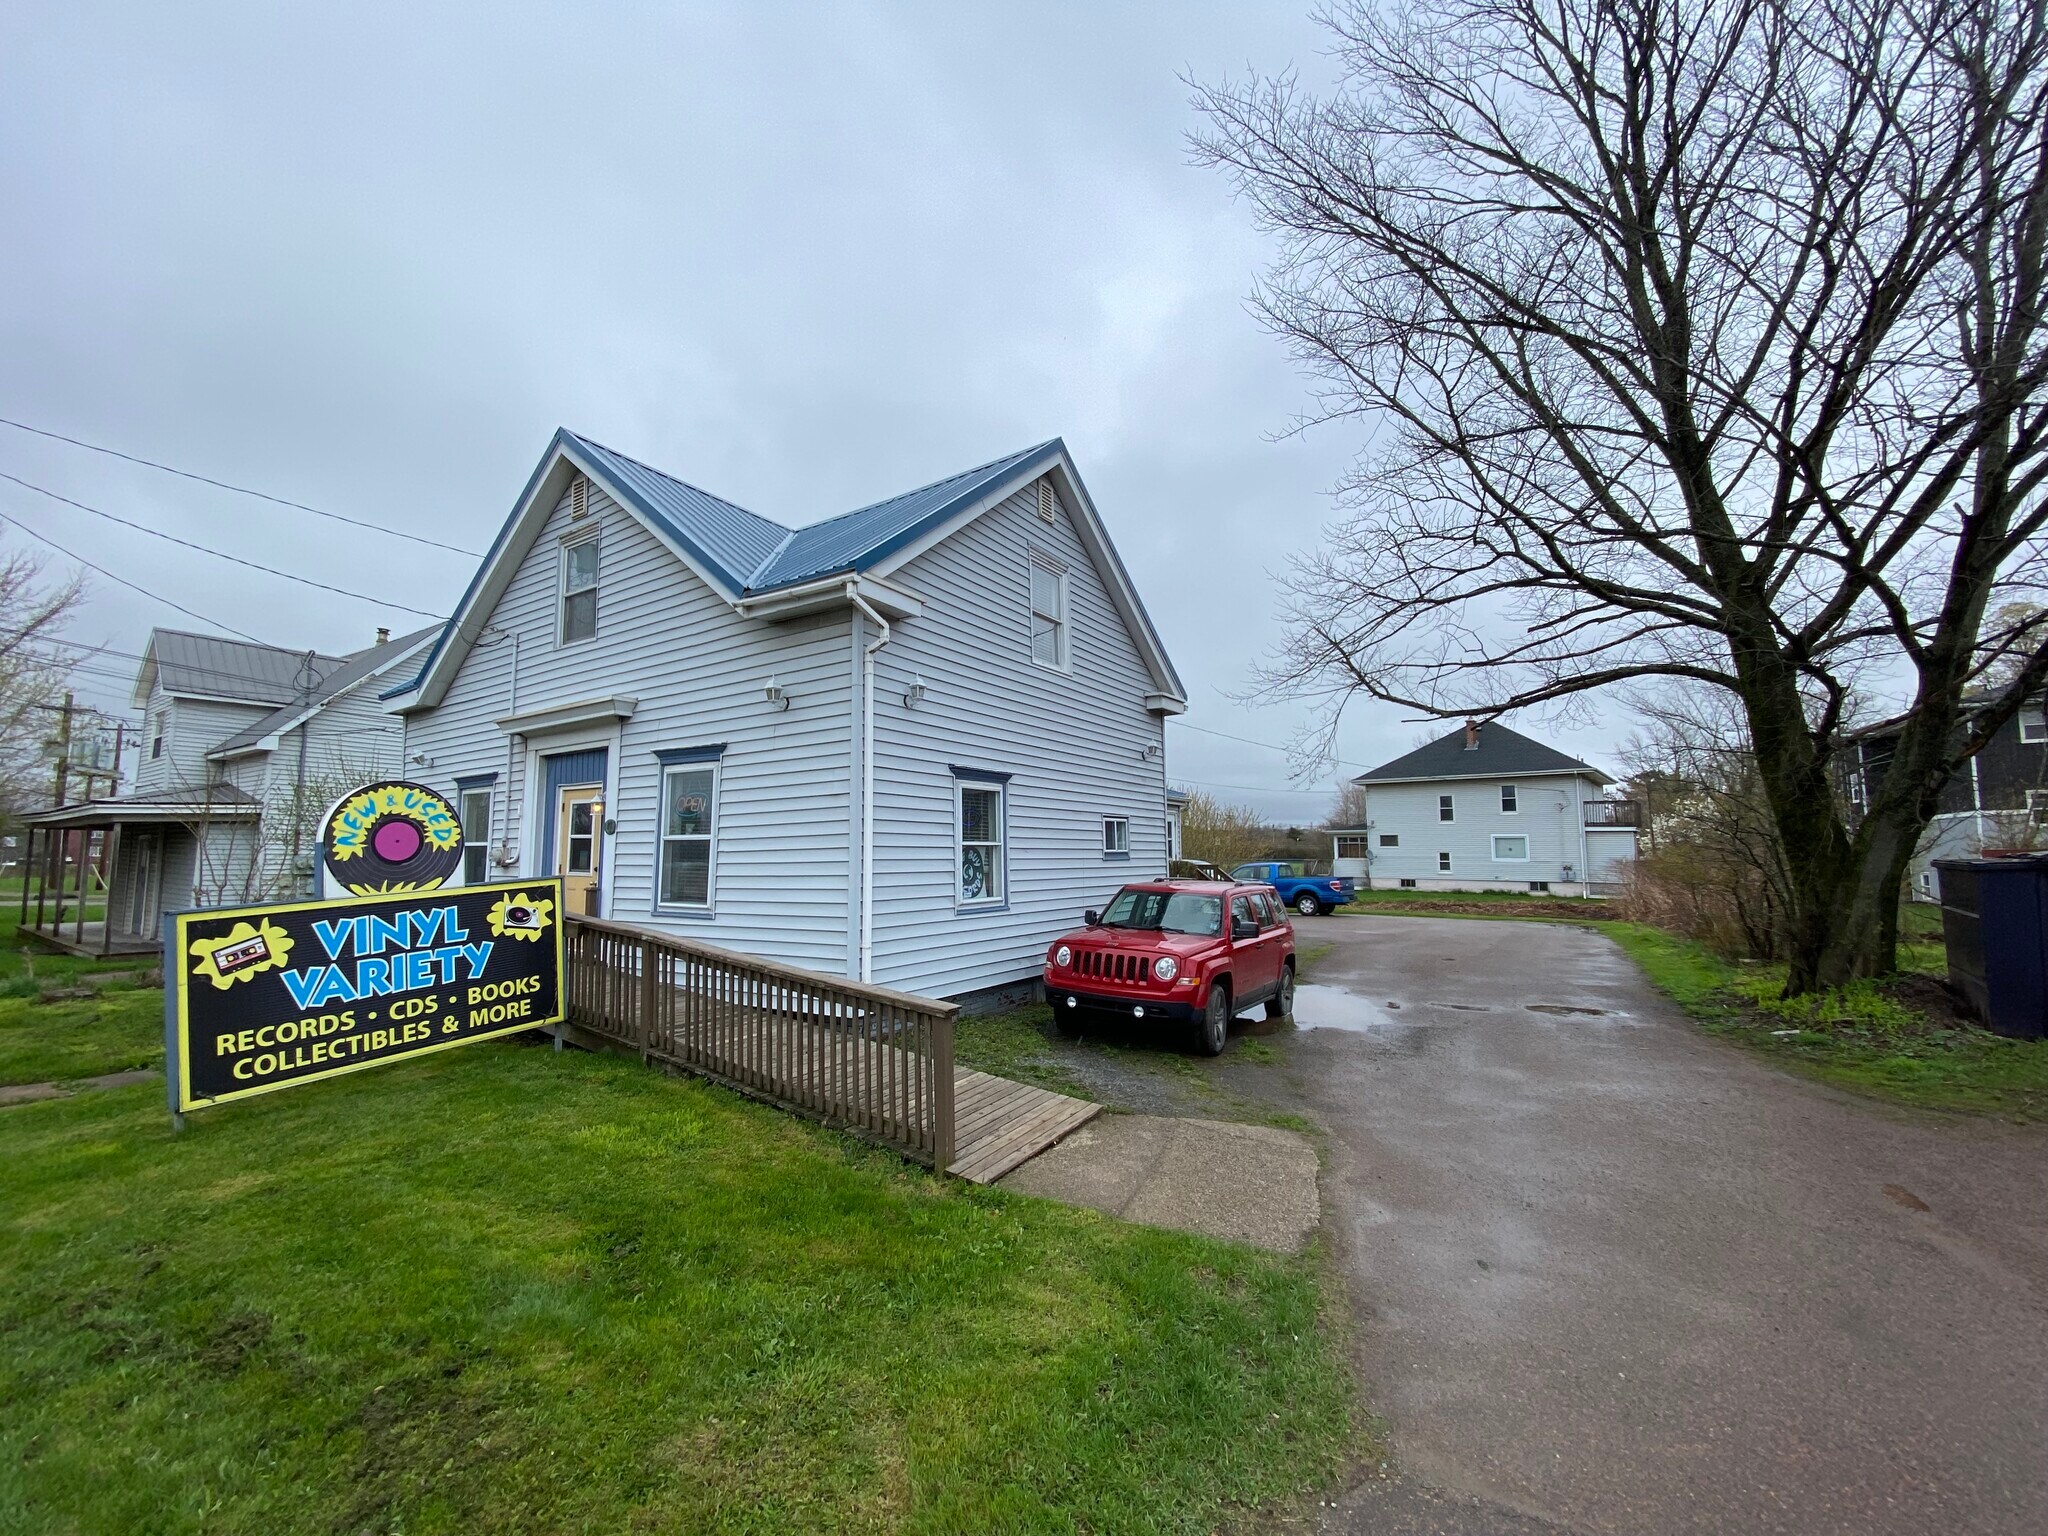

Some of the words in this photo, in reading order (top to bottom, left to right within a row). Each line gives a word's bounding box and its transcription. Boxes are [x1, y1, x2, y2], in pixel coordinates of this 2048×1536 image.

[336, 796, 377, 847] NEW
[386, 794, 398, 807] &
[404, 792, 453, 842] USED
[676, 796, 707, 812] OPEN
[311, 905, 470, 961] VINYL
[279, 941, 495, 1011] VARIETY
[216, 1010, 356, 1056] RECORDS
[389, 994, 439, 1020] CDS
[468, 975, 541, 1005] BOOKS
[233, 1020, 431, 1080] COLLECTIBLES
[441, 1015, 460, 1034] &
[469, 999, 532, 1028] MORE
